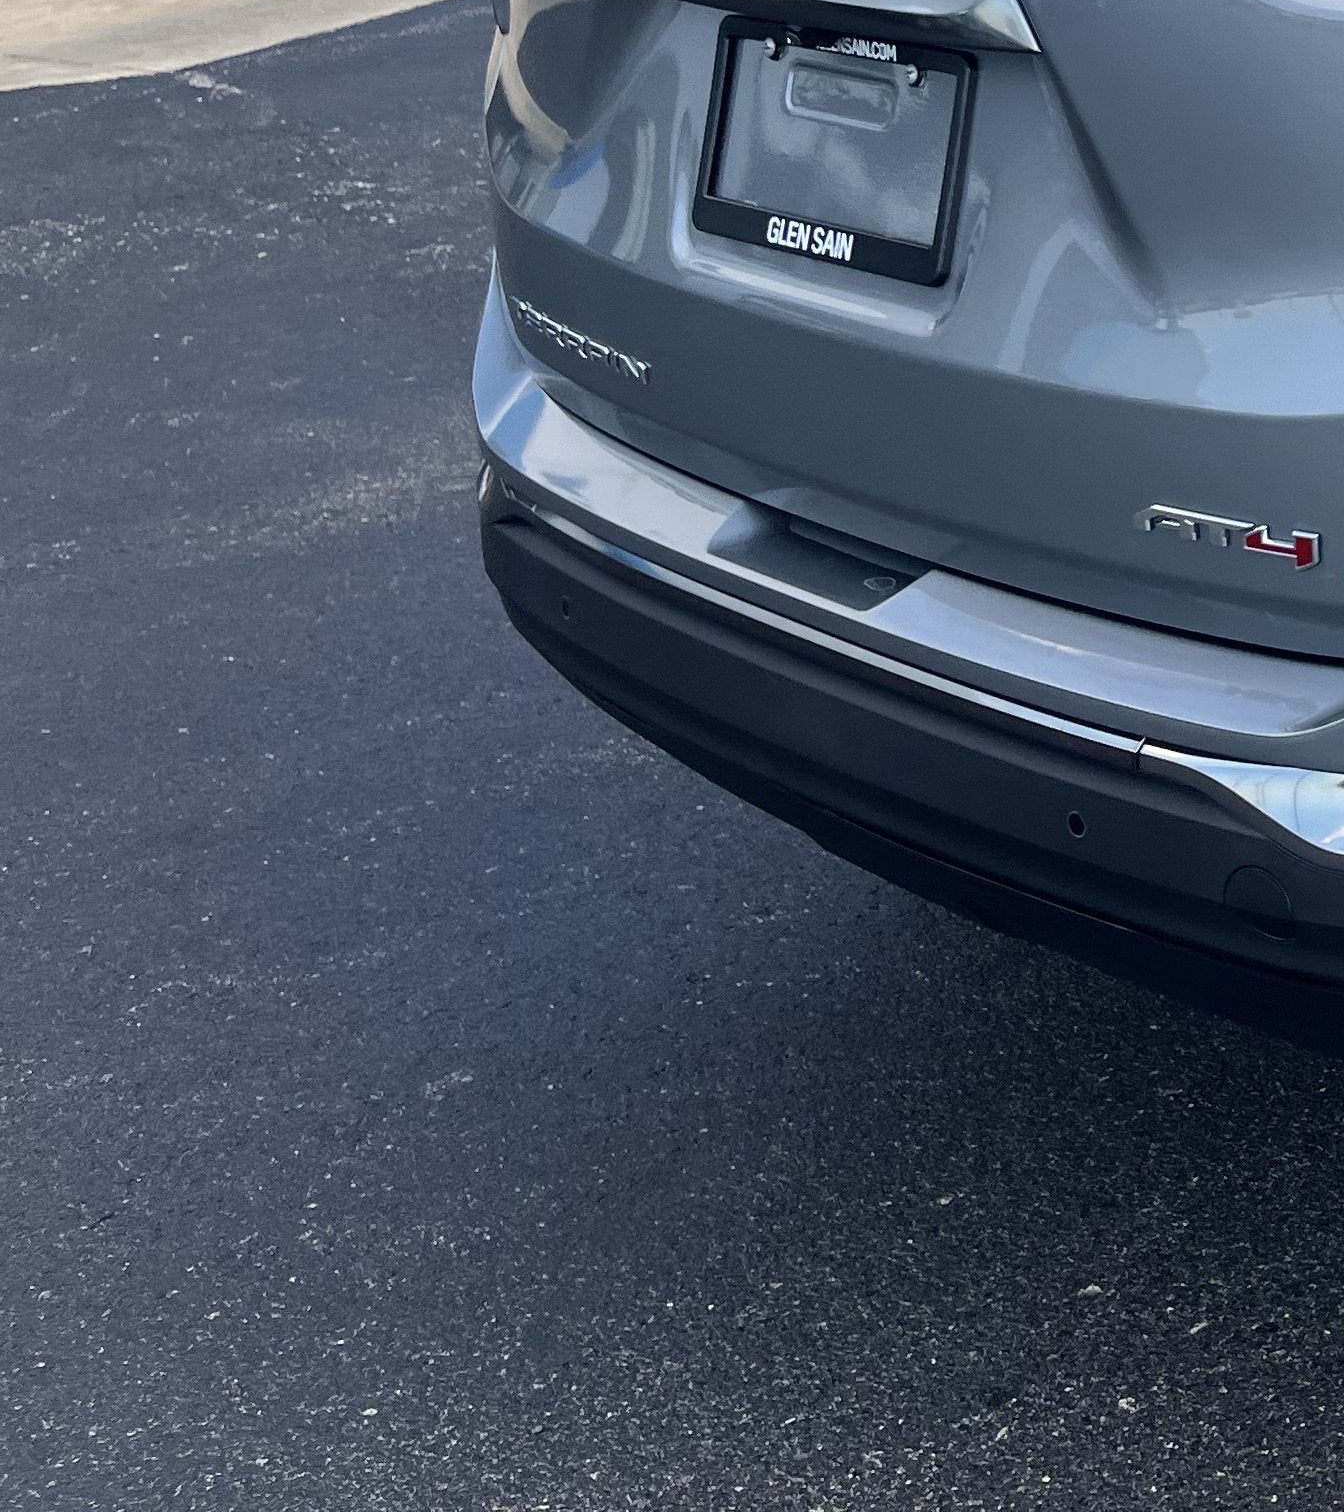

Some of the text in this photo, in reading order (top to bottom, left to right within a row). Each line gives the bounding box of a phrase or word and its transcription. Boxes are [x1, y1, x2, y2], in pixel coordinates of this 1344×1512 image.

[766, 216, 854, 262] GLEN SAIN
[1133, 502, 1321, 571] AT4
